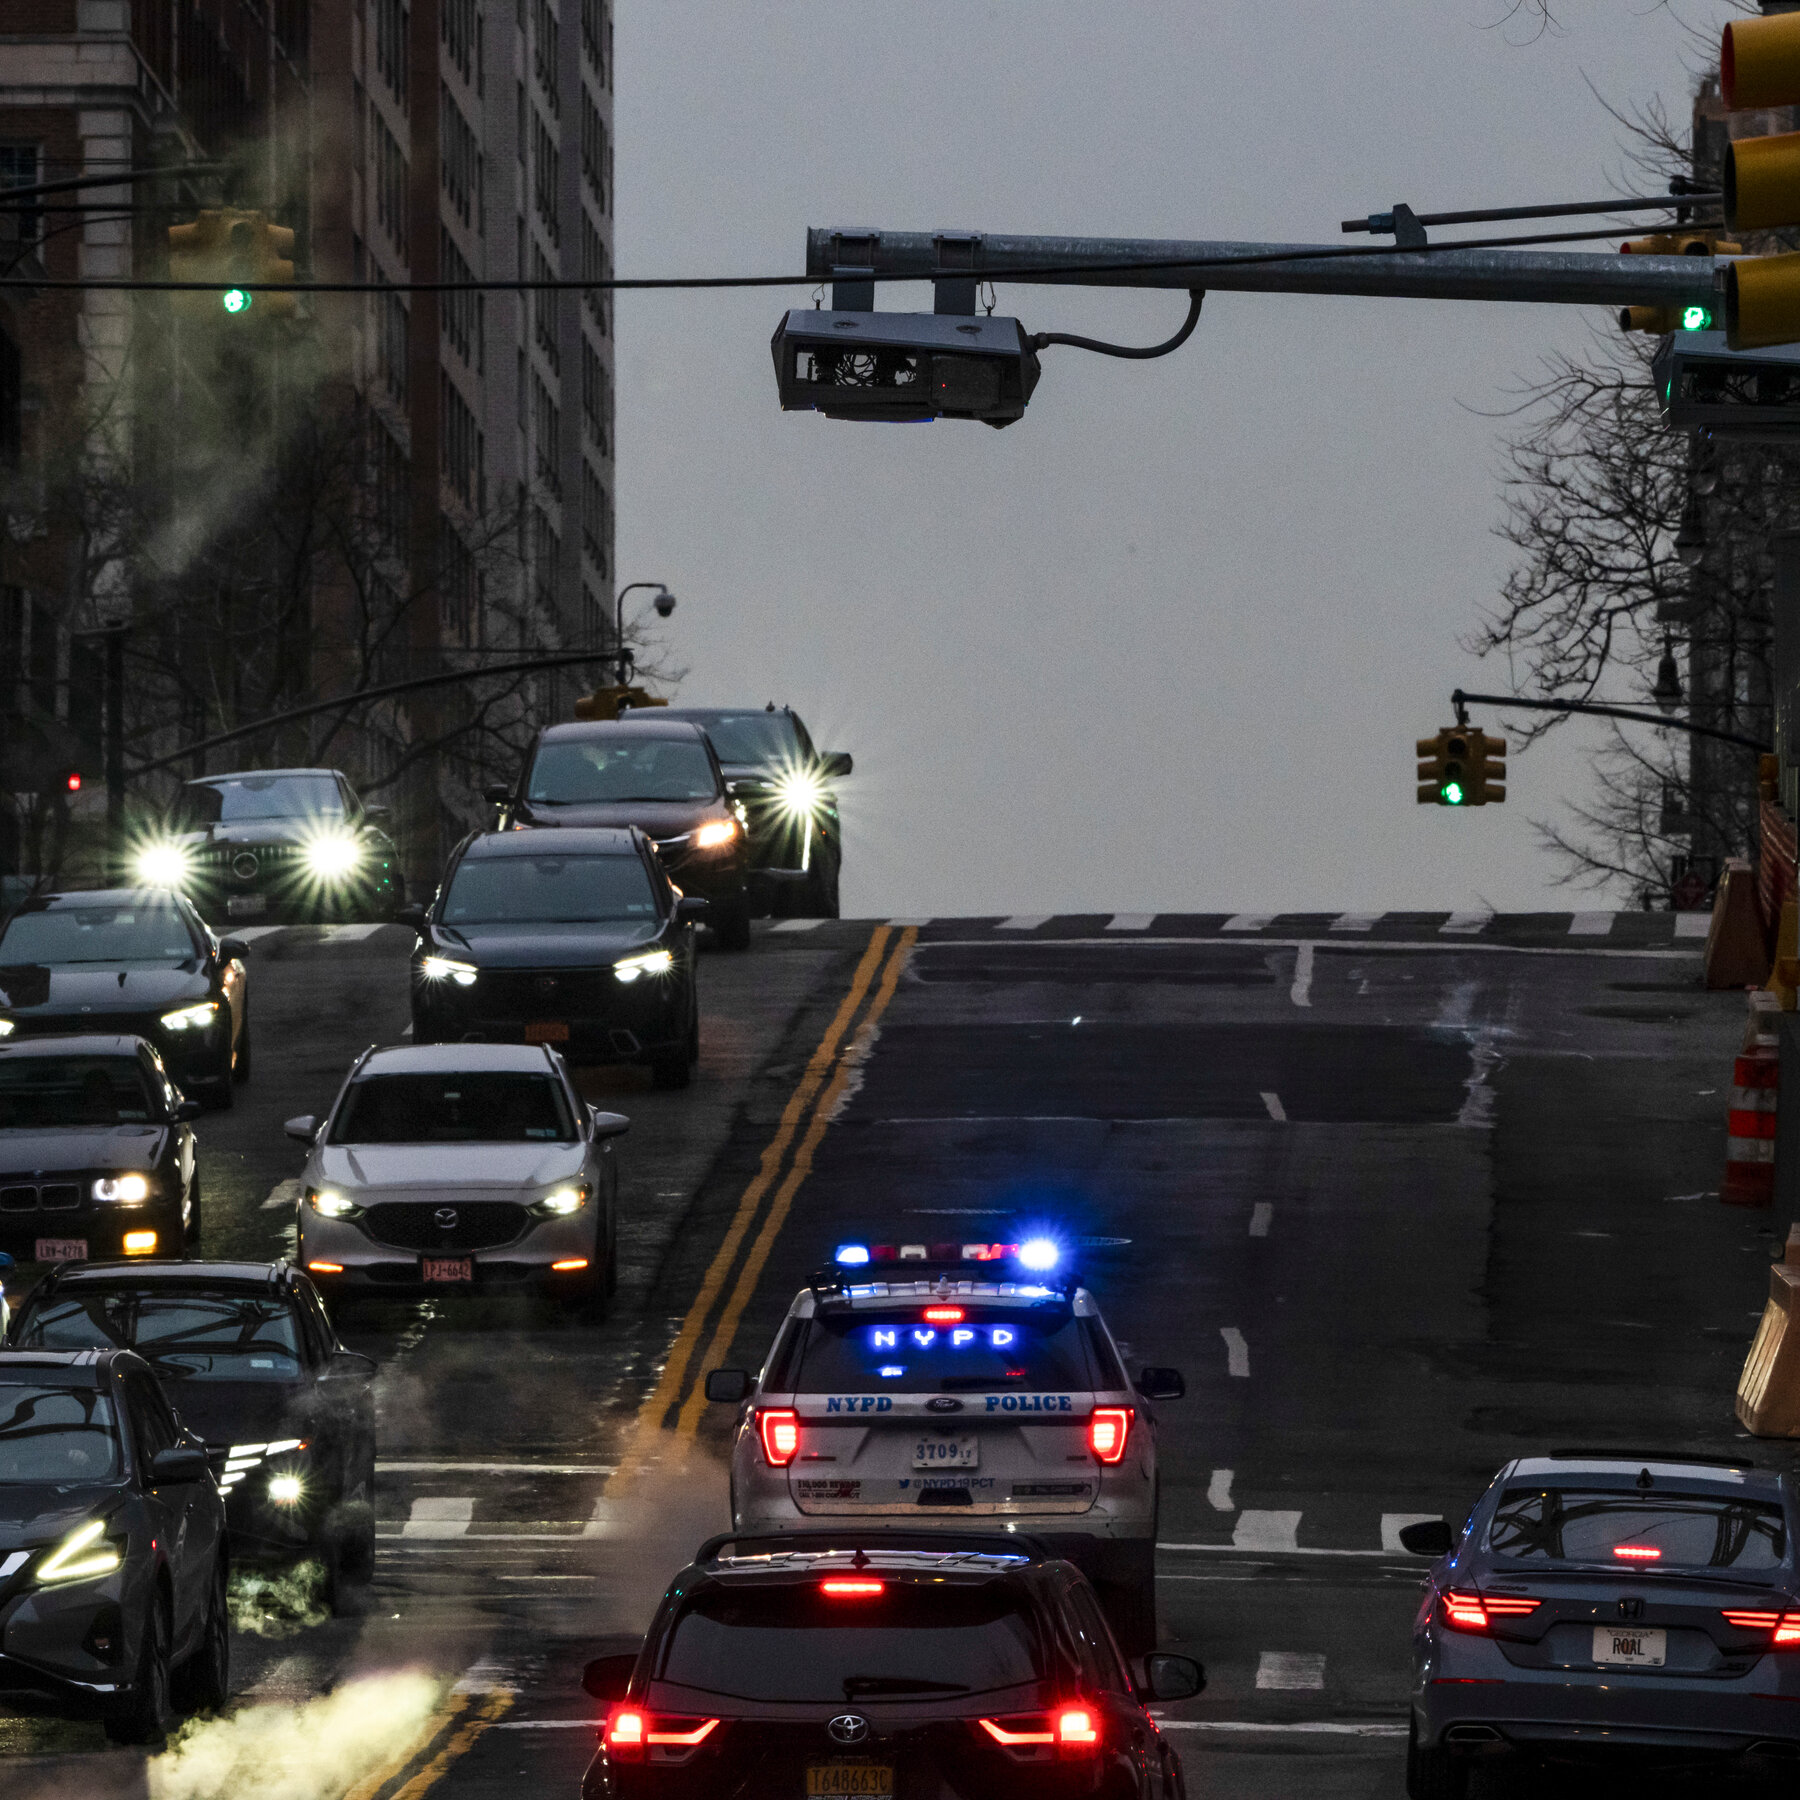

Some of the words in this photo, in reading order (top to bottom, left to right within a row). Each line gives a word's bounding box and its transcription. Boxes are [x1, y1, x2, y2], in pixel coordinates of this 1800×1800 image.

[874, 1330, 1013, 1346] NYPD
[826, 1397, 893, 1413] NYPD
[985, 1395, 1072, 1412] POLICE
[916, 1444, 957, 1460] 3709
[812, 1769, 888, 1792] T648663C
